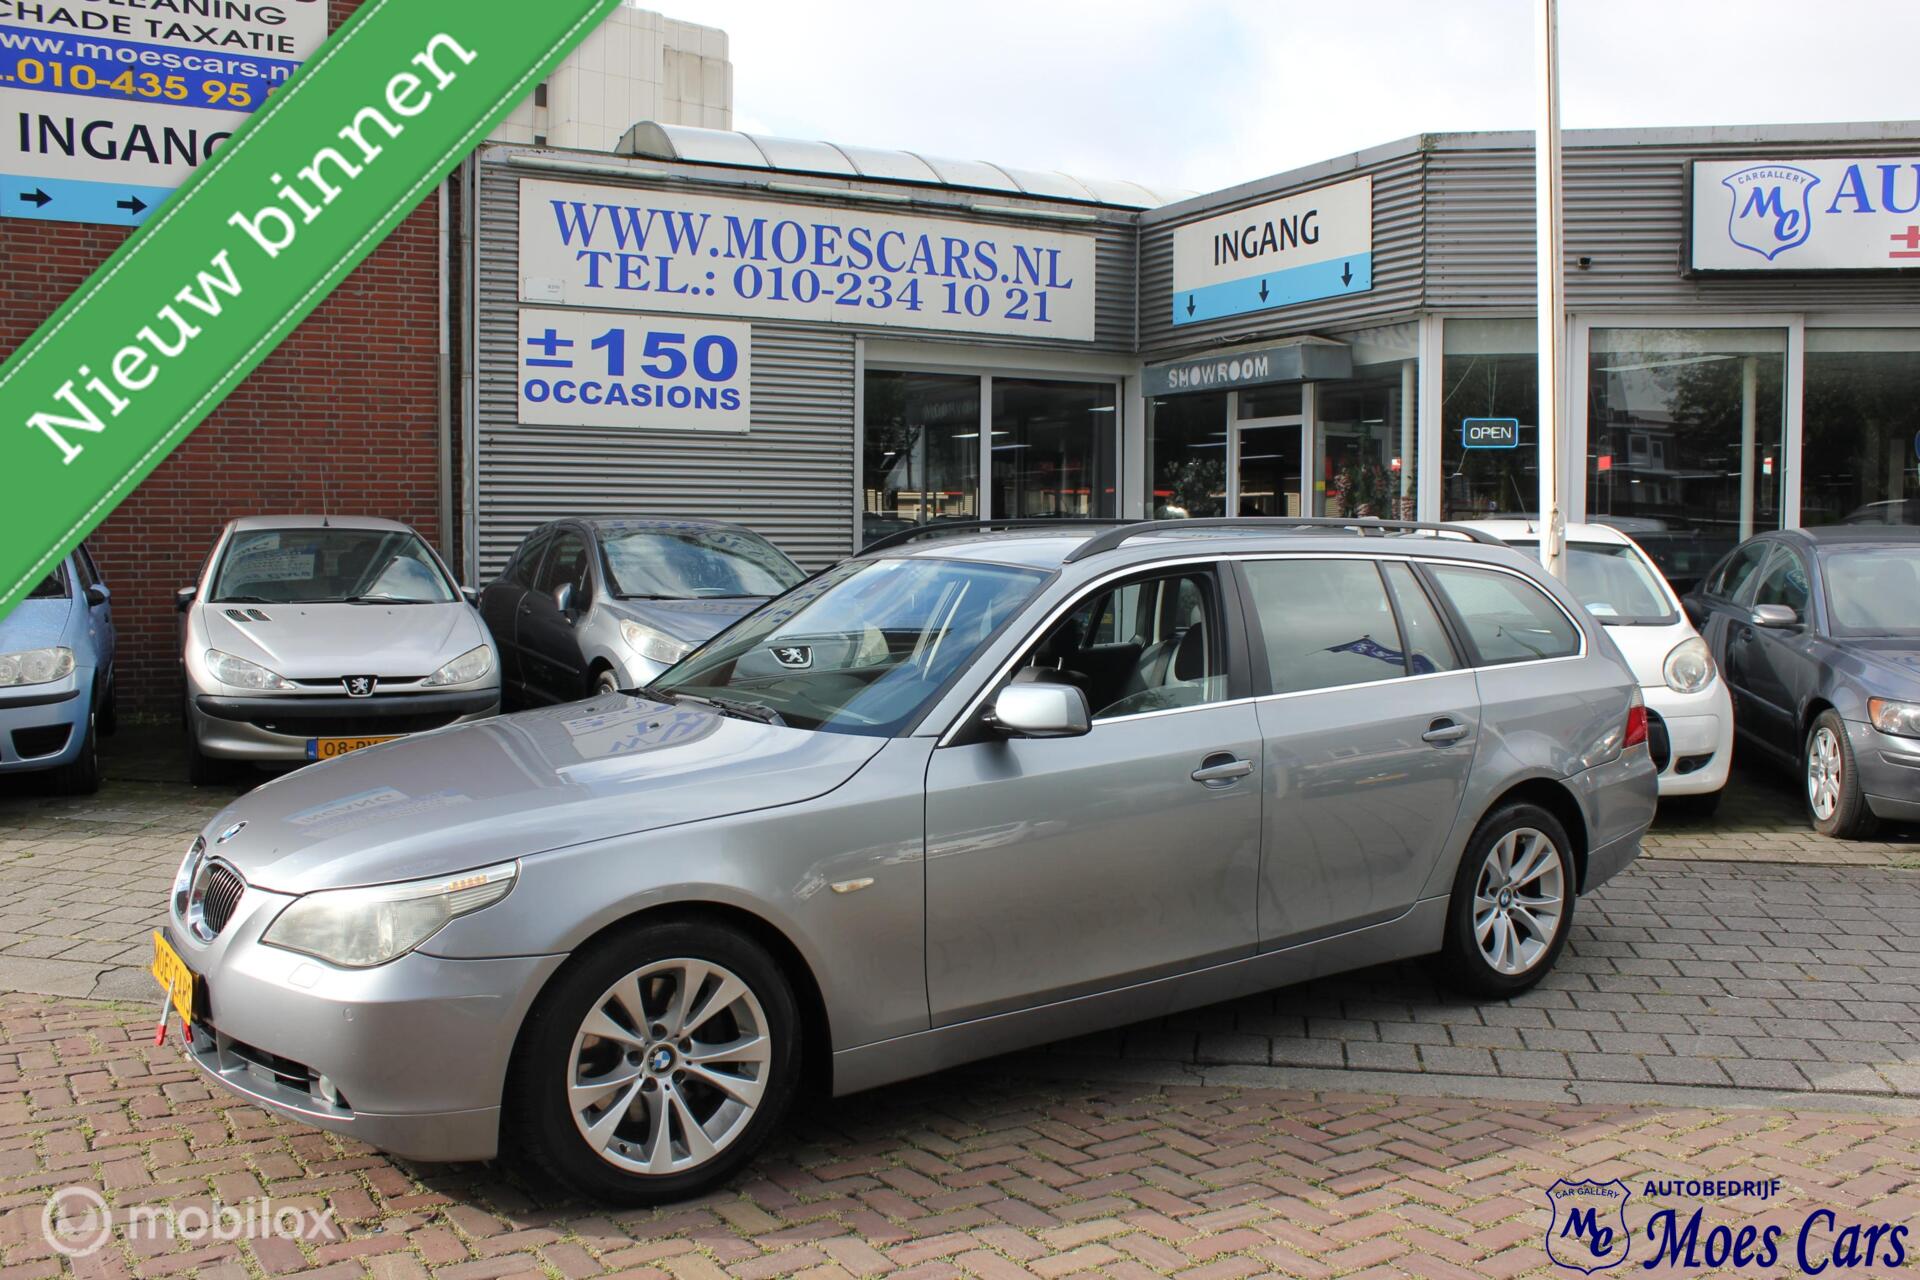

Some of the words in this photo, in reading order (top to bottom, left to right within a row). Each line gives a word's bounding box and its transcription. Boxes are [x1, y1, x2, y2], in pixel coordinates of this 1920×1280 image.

[84, 0, 287, 25] ANING
[145, 19, 295, 54] TAXATIE
[201, 79, 252, 107] 95
[549, 200, 1074, 290] WWW.MOESCARS.NL
[1214, 209, 1320, 267] INGANG
[576, 250, 716, 297] TEL.:
[732, 263, 924, 313] 010-234
[941, 281, 991, 318] 10
[1003, 286, 1053, 323] 21
[1168, 355, 1269, 389] SHOWROOM
[523, 378, 741, 411] OCCASIONS
[1469, 425, 1513, 441] OPEN
